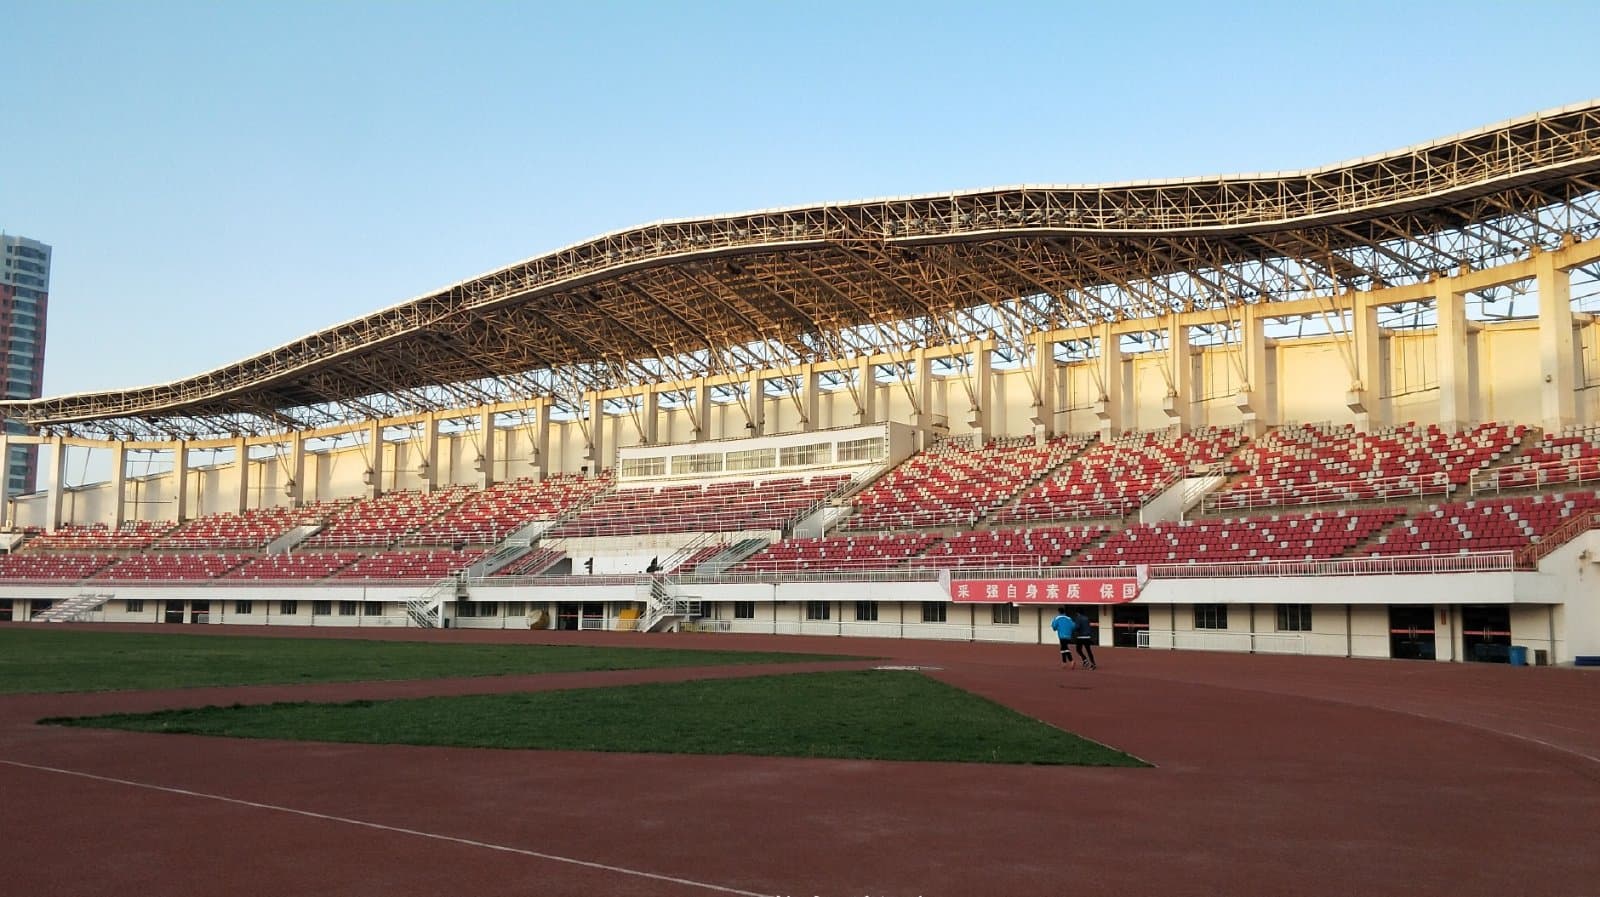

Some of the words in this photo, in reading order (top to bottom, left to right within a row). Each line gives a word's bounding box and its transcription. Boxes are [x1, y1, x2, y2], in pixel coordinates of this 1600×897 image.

[986, 583, 1081, 599] 强自身素质
